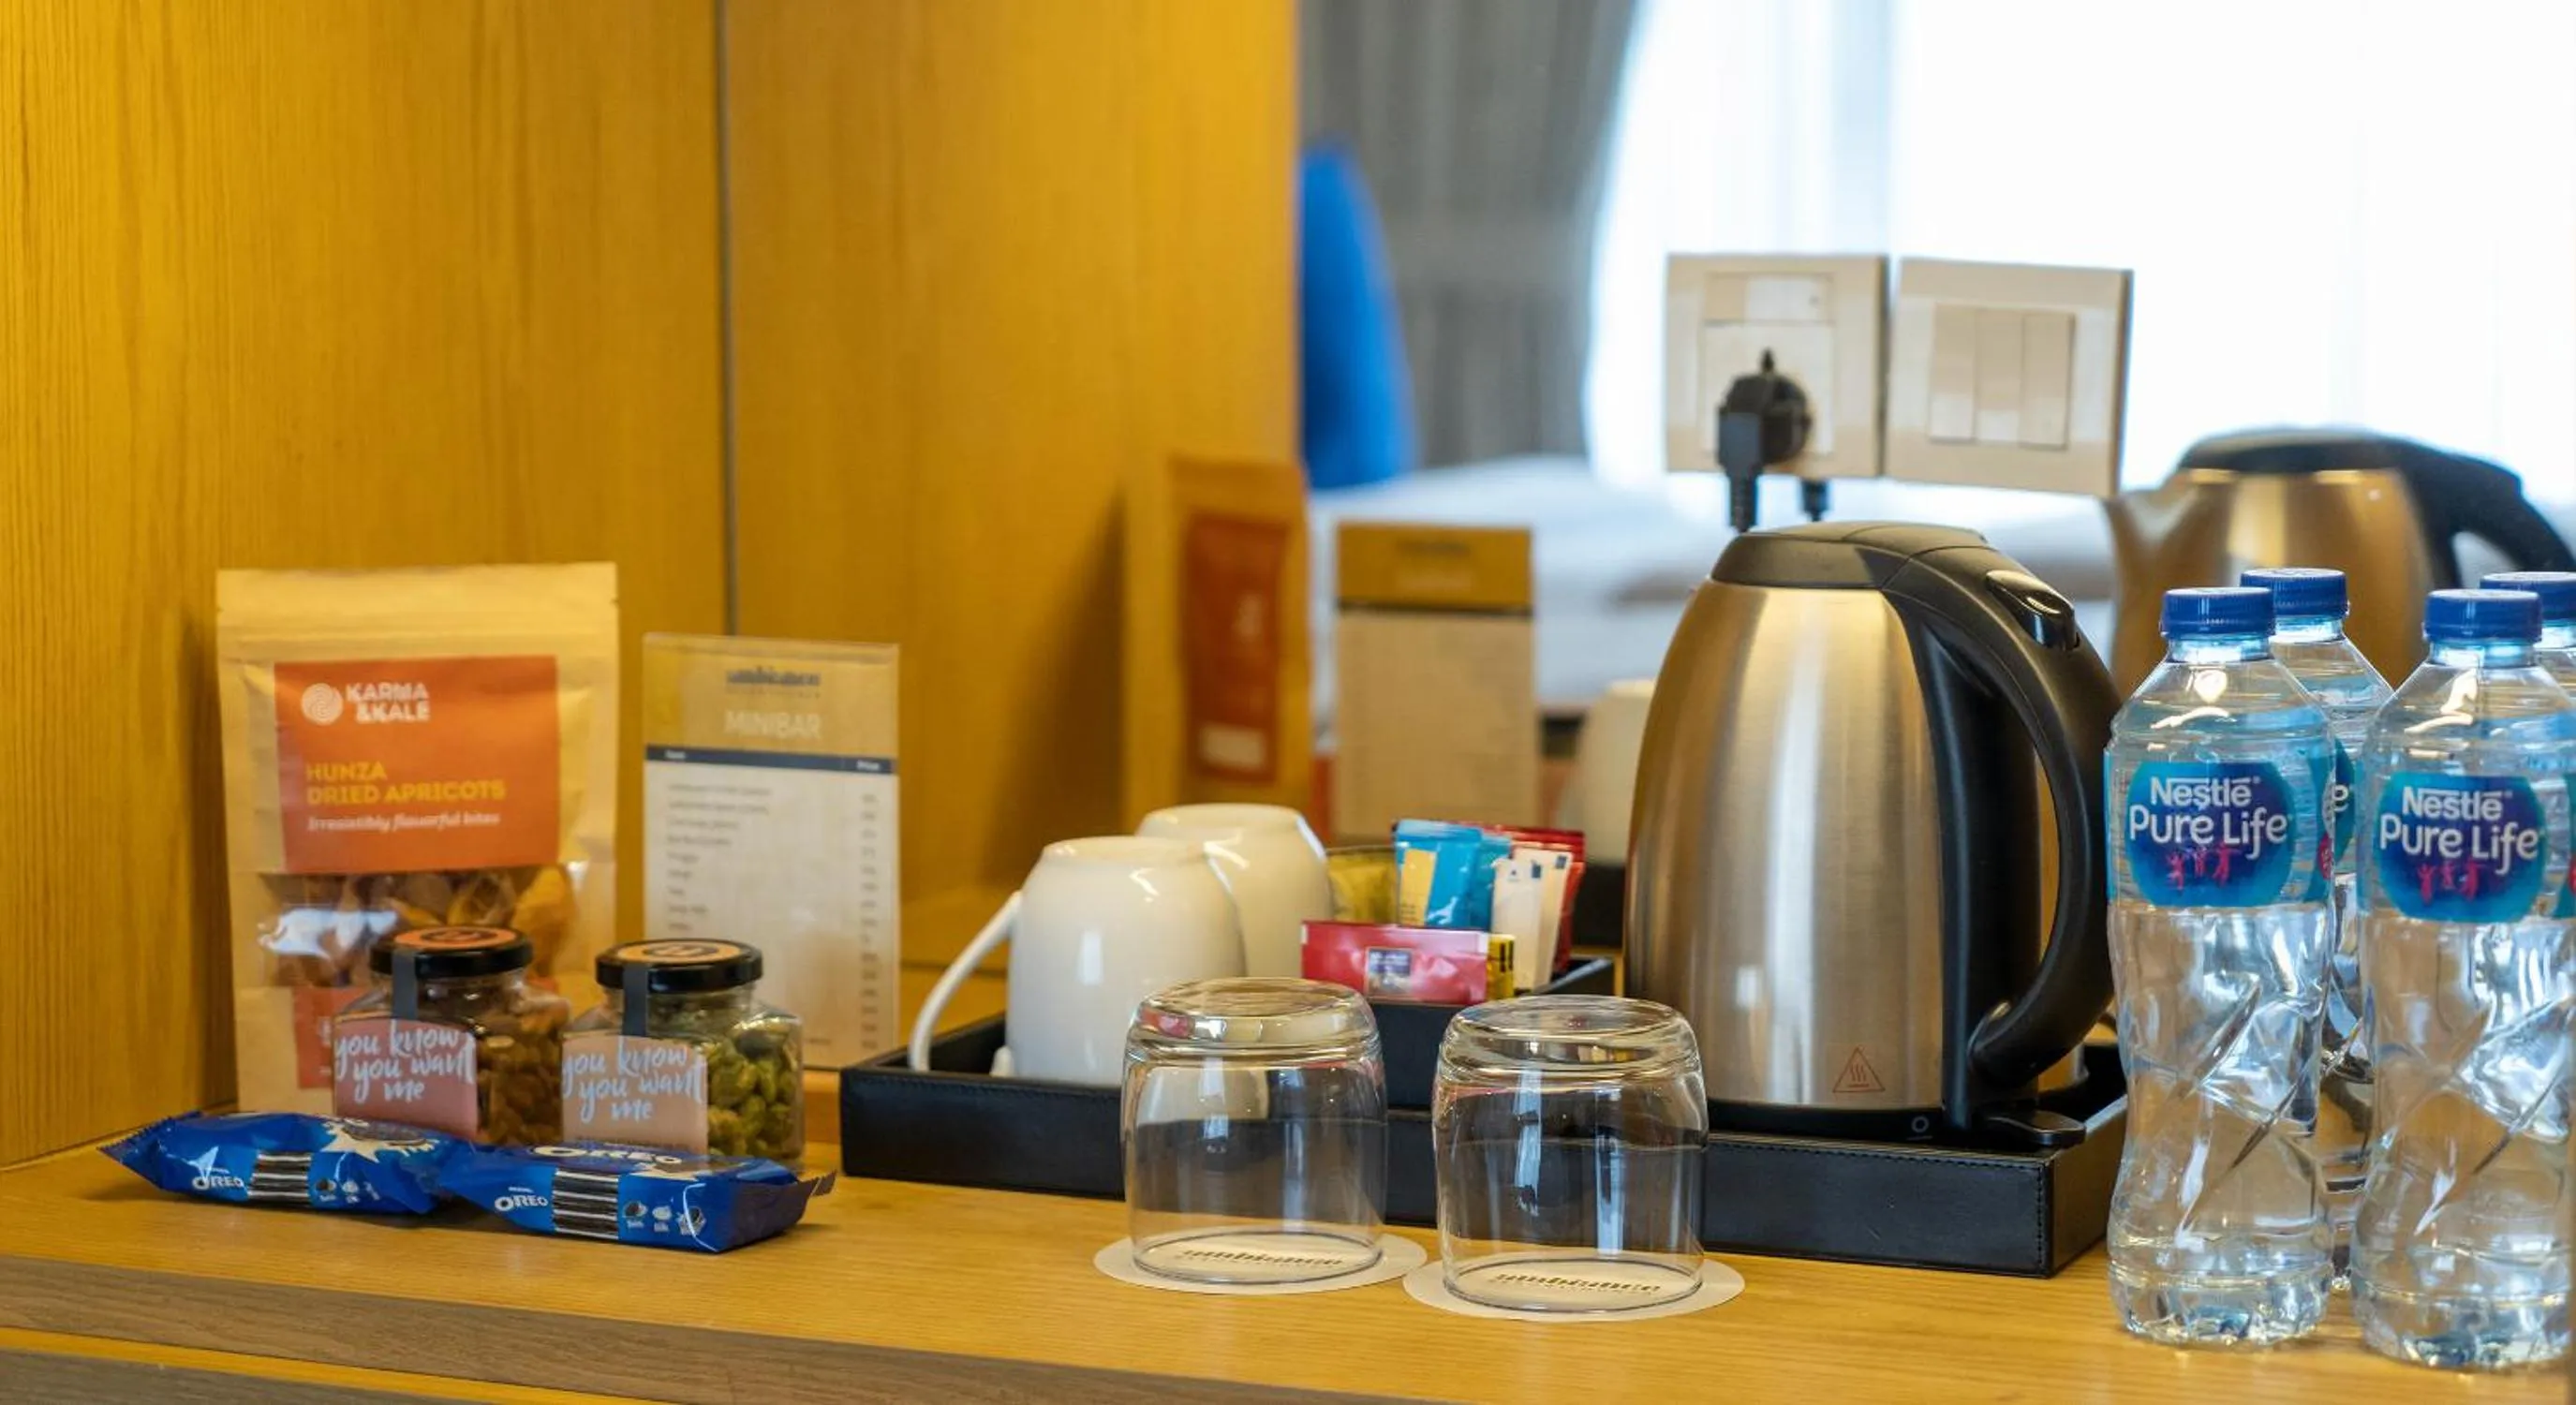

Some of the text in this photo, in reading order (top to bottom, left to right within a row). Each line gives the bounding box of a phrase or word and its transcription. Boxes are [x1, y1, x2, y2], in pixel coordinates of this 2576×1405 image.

[346, 682, 430, 702] KARMA
[356, 702, 431, 724] &KALE
[724, 709, 822, 740] MINIBAR
[305, 761, 388, 782] HUNZA
[306, 779, 506, 806] DRIED APRICOTS
[2150, 776, 2252, 810] Nestlé
[2402, 786, 2503, 821] Nestlé
[2129, 805, 2214, 845] Pure
[2222, 806, 2287, 860] Life
[2380, 812, 2539, 875] Pure Life
[333, 1018, 459, 1082] you know
[353, 1030, 477, 1105] you want
[562, 1035, 688, 1099] you know
[383, 1080, 424, 1103] me
[579, 1053, 707, 1123] you want
[611, 1098, 653, 1122] me
[533, 1146, 683, 1164] OREO
[191, 1176, 244, 1191] OREO
[494, 1194, 549, 1212] OREO
